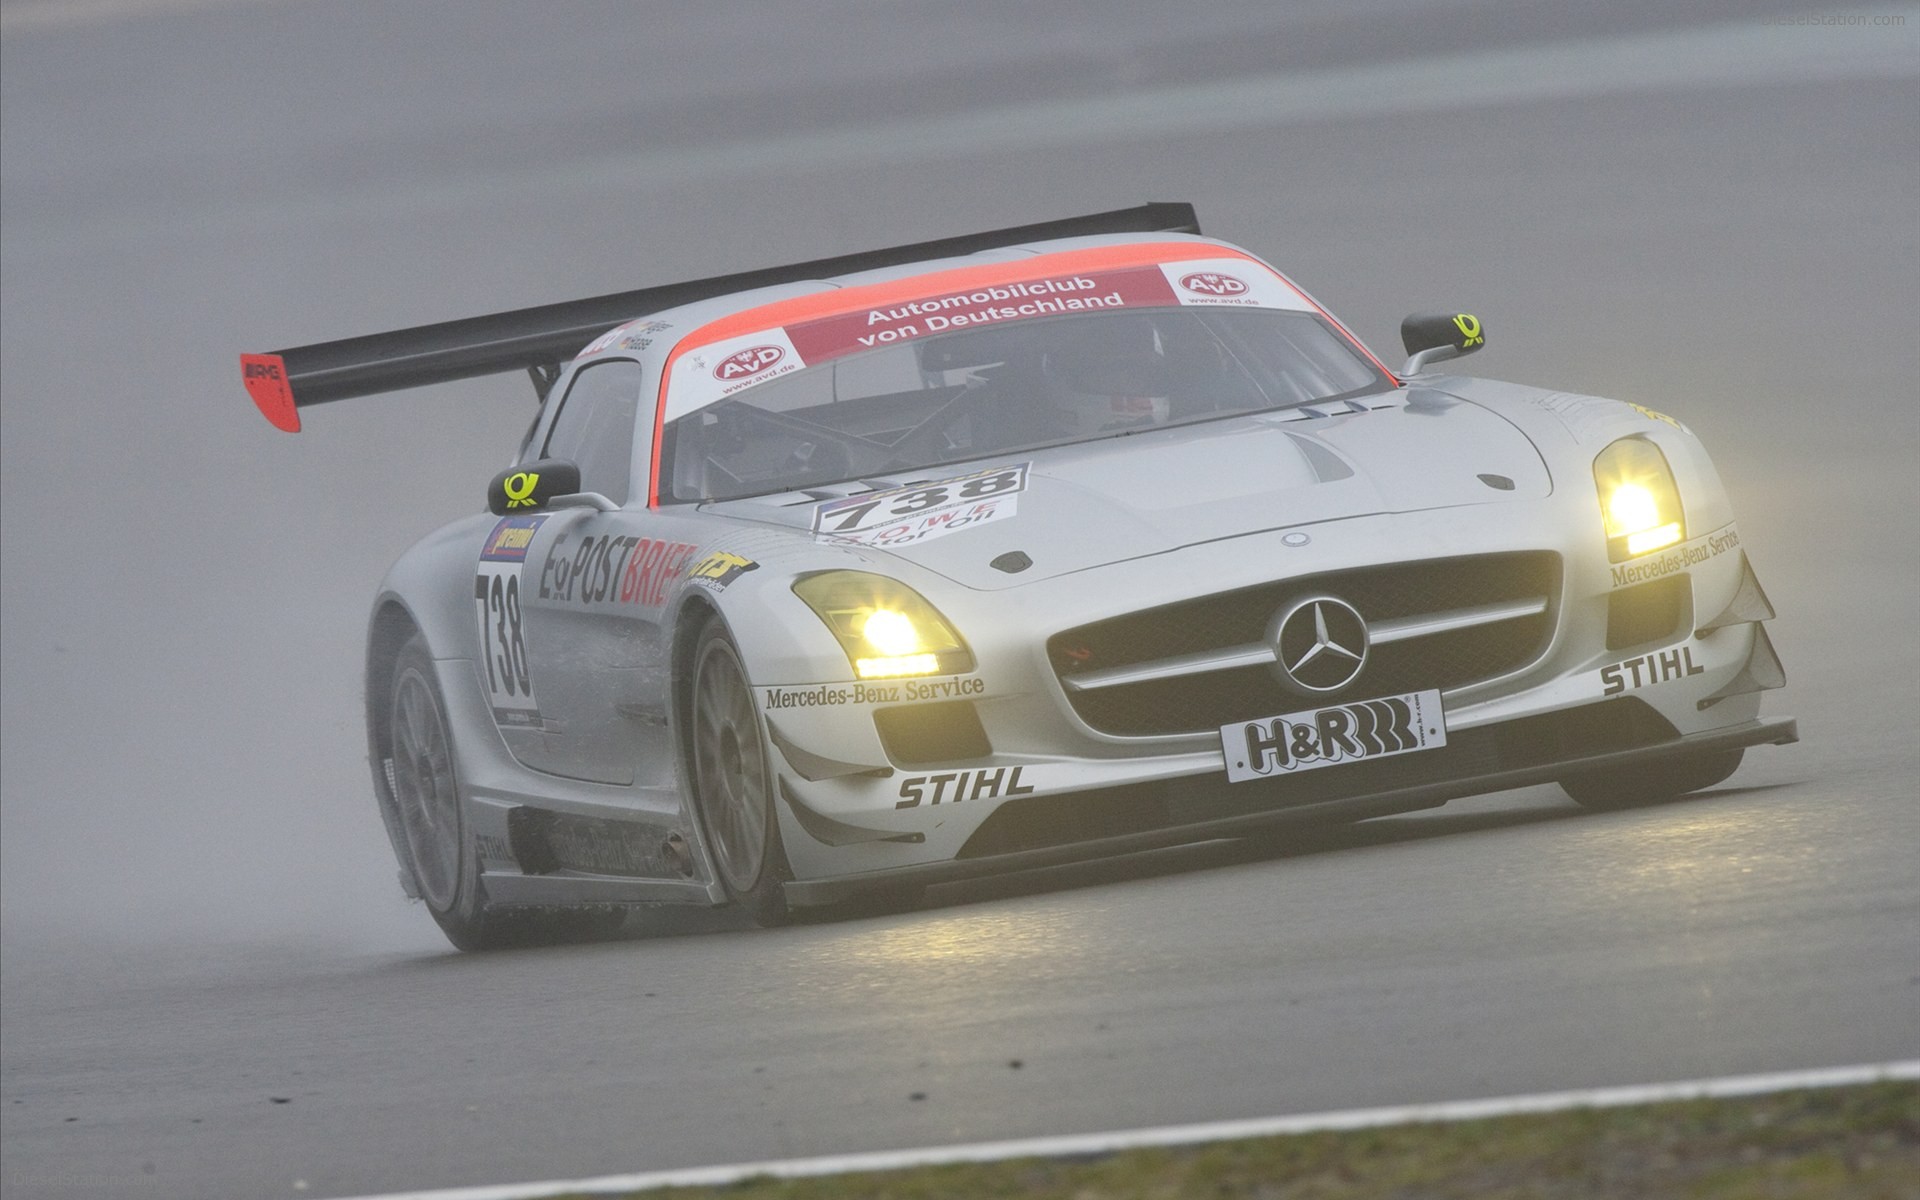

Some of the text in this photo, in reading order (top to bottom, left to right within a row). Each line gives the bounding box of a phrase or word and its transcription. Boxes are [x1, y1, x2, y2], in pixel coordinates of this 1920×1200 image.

[867, 277, 1096, 326] Automobilclub
[1189, 278, 1245, 294] AvD
[857, 292, 1124, 347] von Deutschland
[722, 363, 795, 394] www.avd.de
[723, 348, 781, 379] AvD
[824, 471, 1018, 531] 738
[944, 510, 997, 530] Oil
[1610, 530, 1740, 588] Mercedes-Benz Service
[475, 574, 531, 697] 738
[766, 676, 985, 709] Mercedes-Benz Service
[1600, 647, 1704, 696] STIHL
[895, 766, 1034, 810] STIHL
